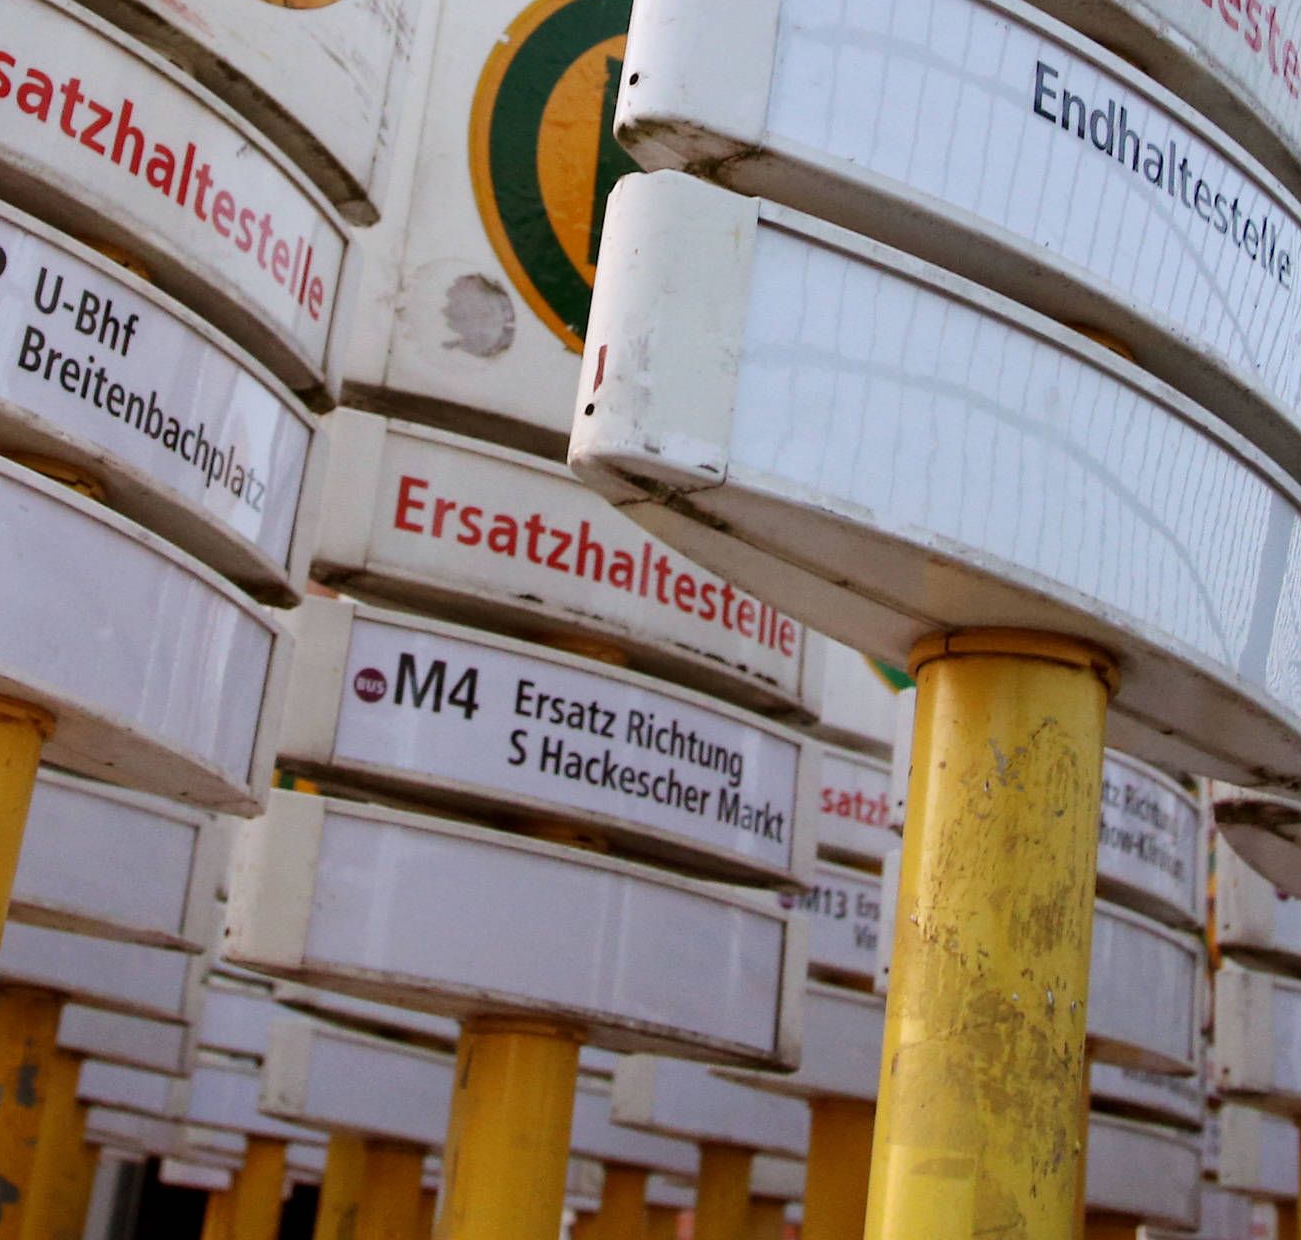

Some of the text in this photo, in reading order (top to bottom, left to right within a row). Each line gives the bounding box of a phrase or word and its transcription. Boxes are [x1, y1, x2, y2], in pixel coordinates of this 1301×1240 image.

[1033, 59, 1293, 291] Endhaltestelle
[33, 265, 139, 358] U-Bhf
[16, 325, 267, 514] Breitenbachplatz
[391, 474, 797, 658] Ersatzhaltestelle
[393, 651, 480, 721] M4
[513, 679, 616, 739] Ersatz
[626, 709, 744, 790] Richtung
[507, 727, 784, 845] S Hackescher Markt
